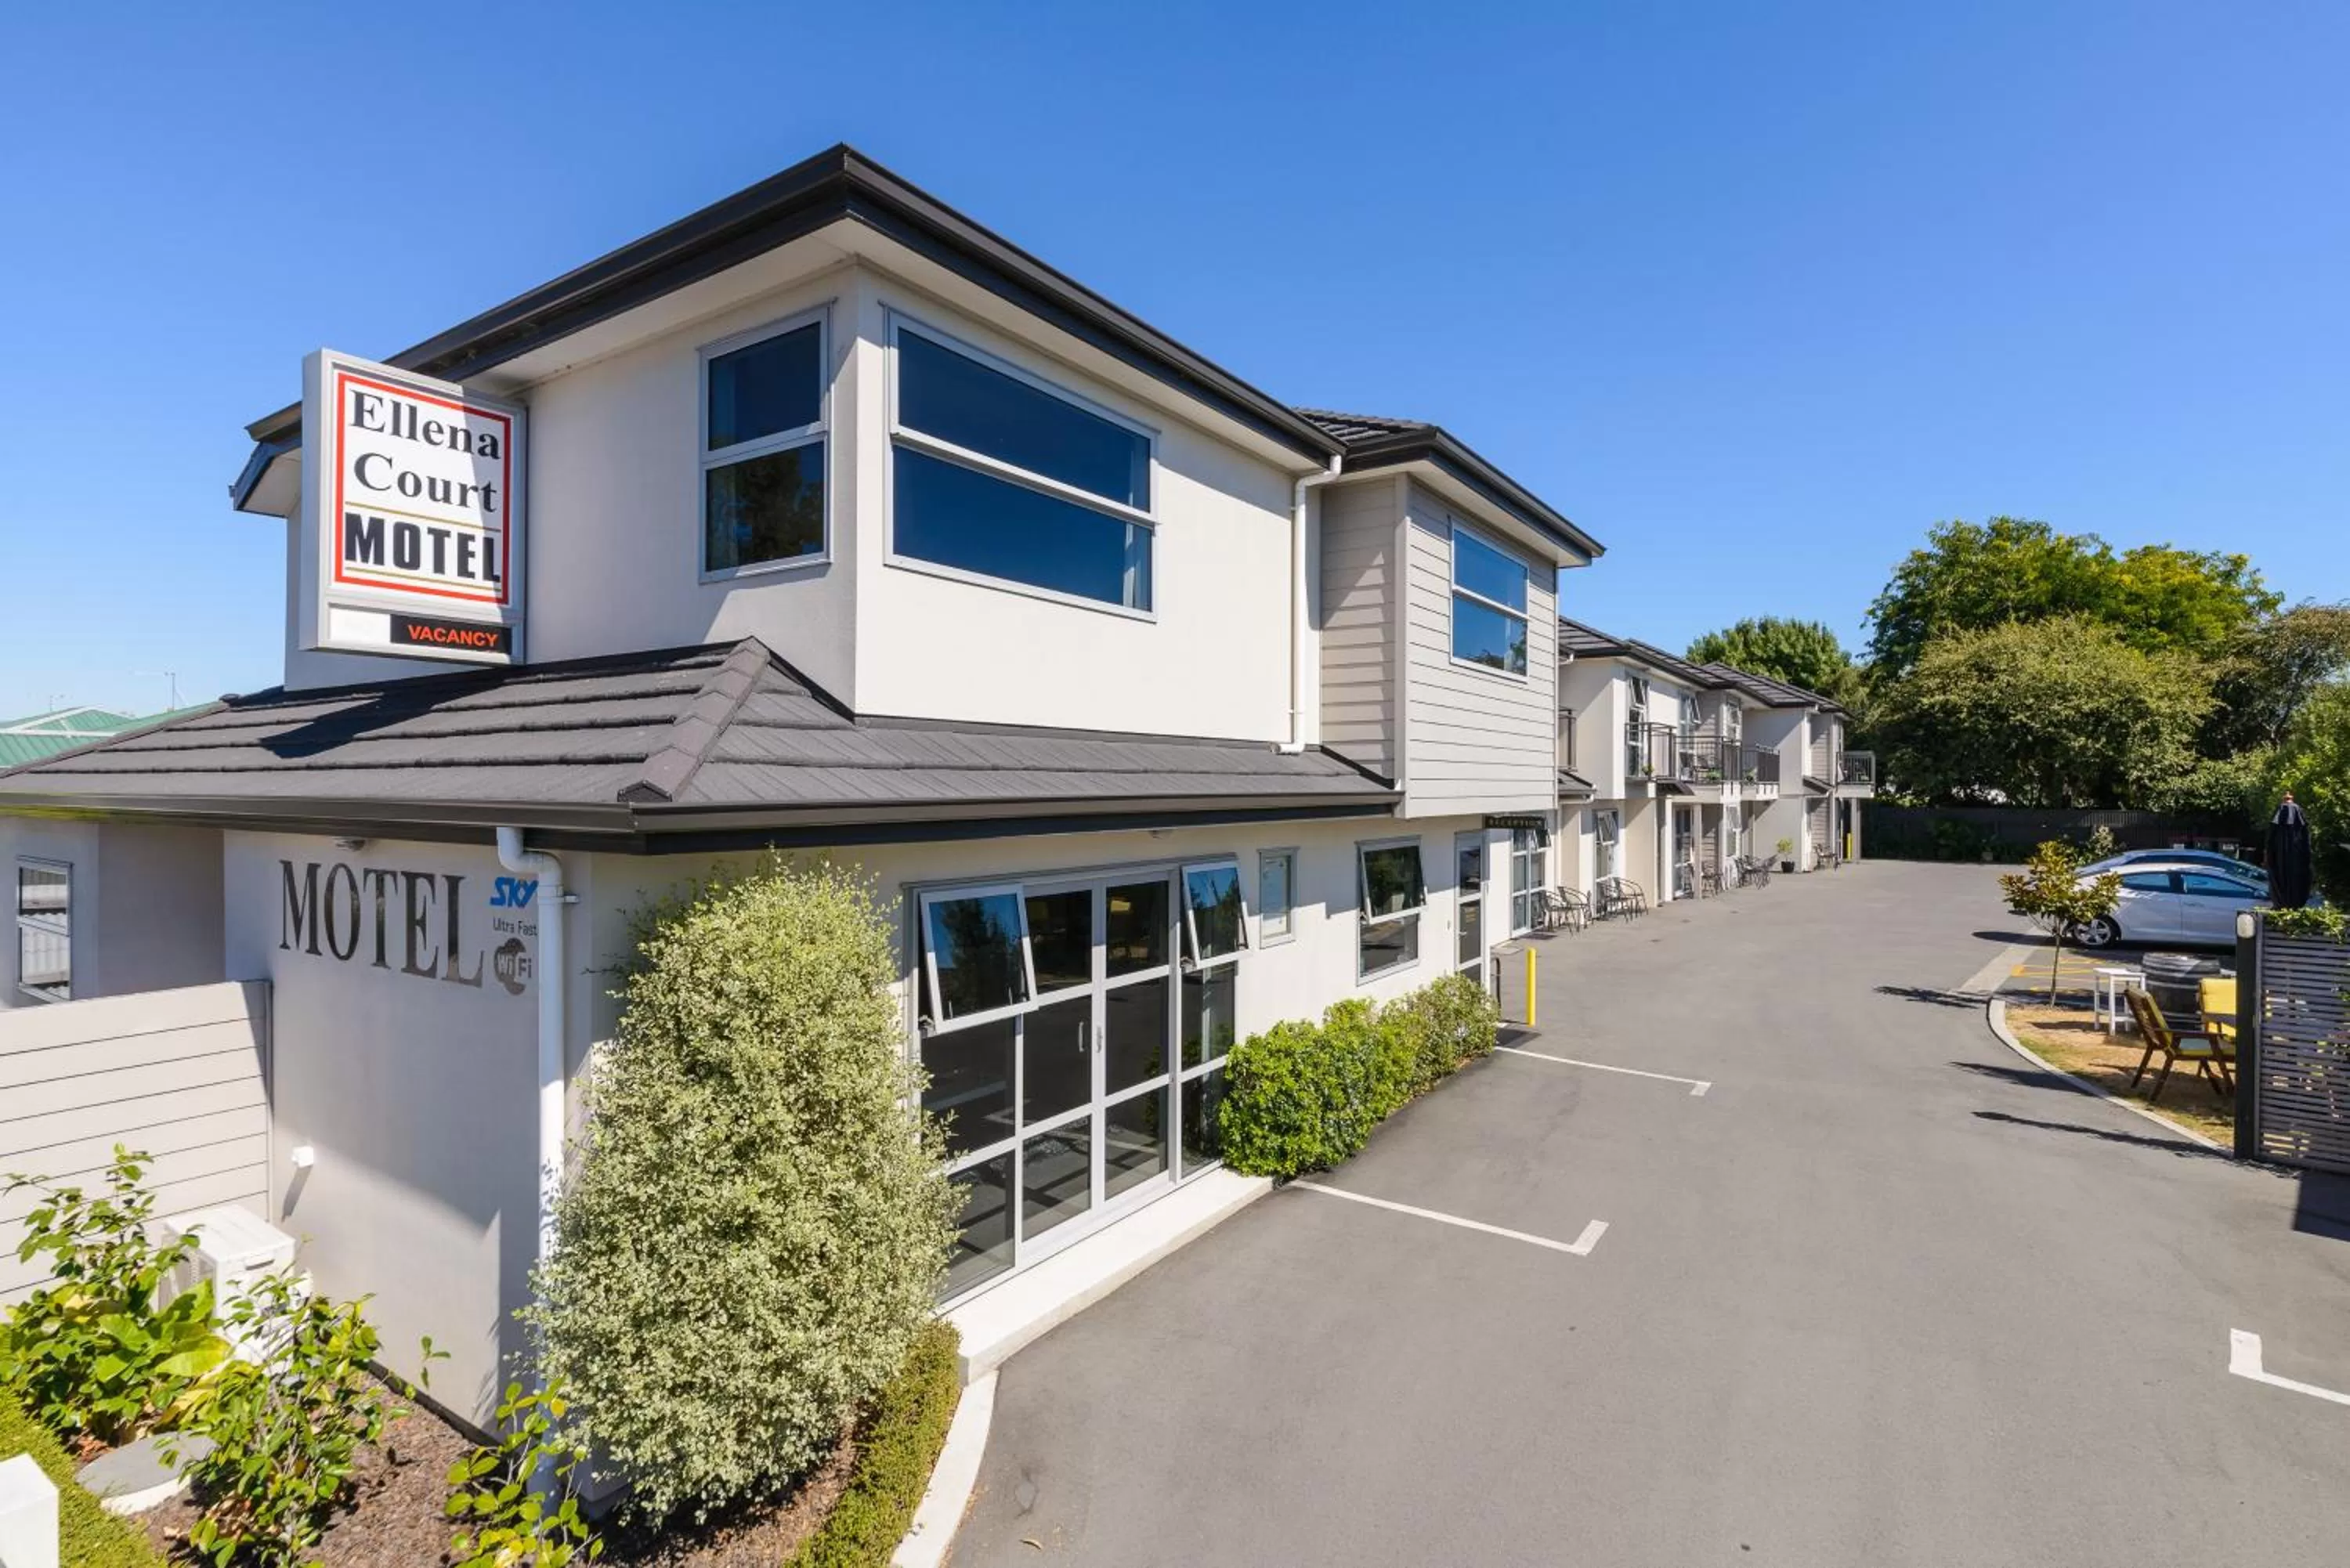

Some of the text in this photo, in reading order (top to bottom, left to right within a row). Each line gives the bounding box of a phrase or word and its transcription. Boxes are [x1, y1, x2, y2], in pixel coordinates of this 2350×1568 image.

[349, 390, 501, 460] Ellena
[354, 452, 498, 513] Court
[345, 511, 501, 583] MOTEL
[407, 624, 498, 647] VACANCY
[490, 876, 539, 909] SKY
[279, 859, 484, 988] MOTEL
[493, 916, 538, 936] Ultra Fast
